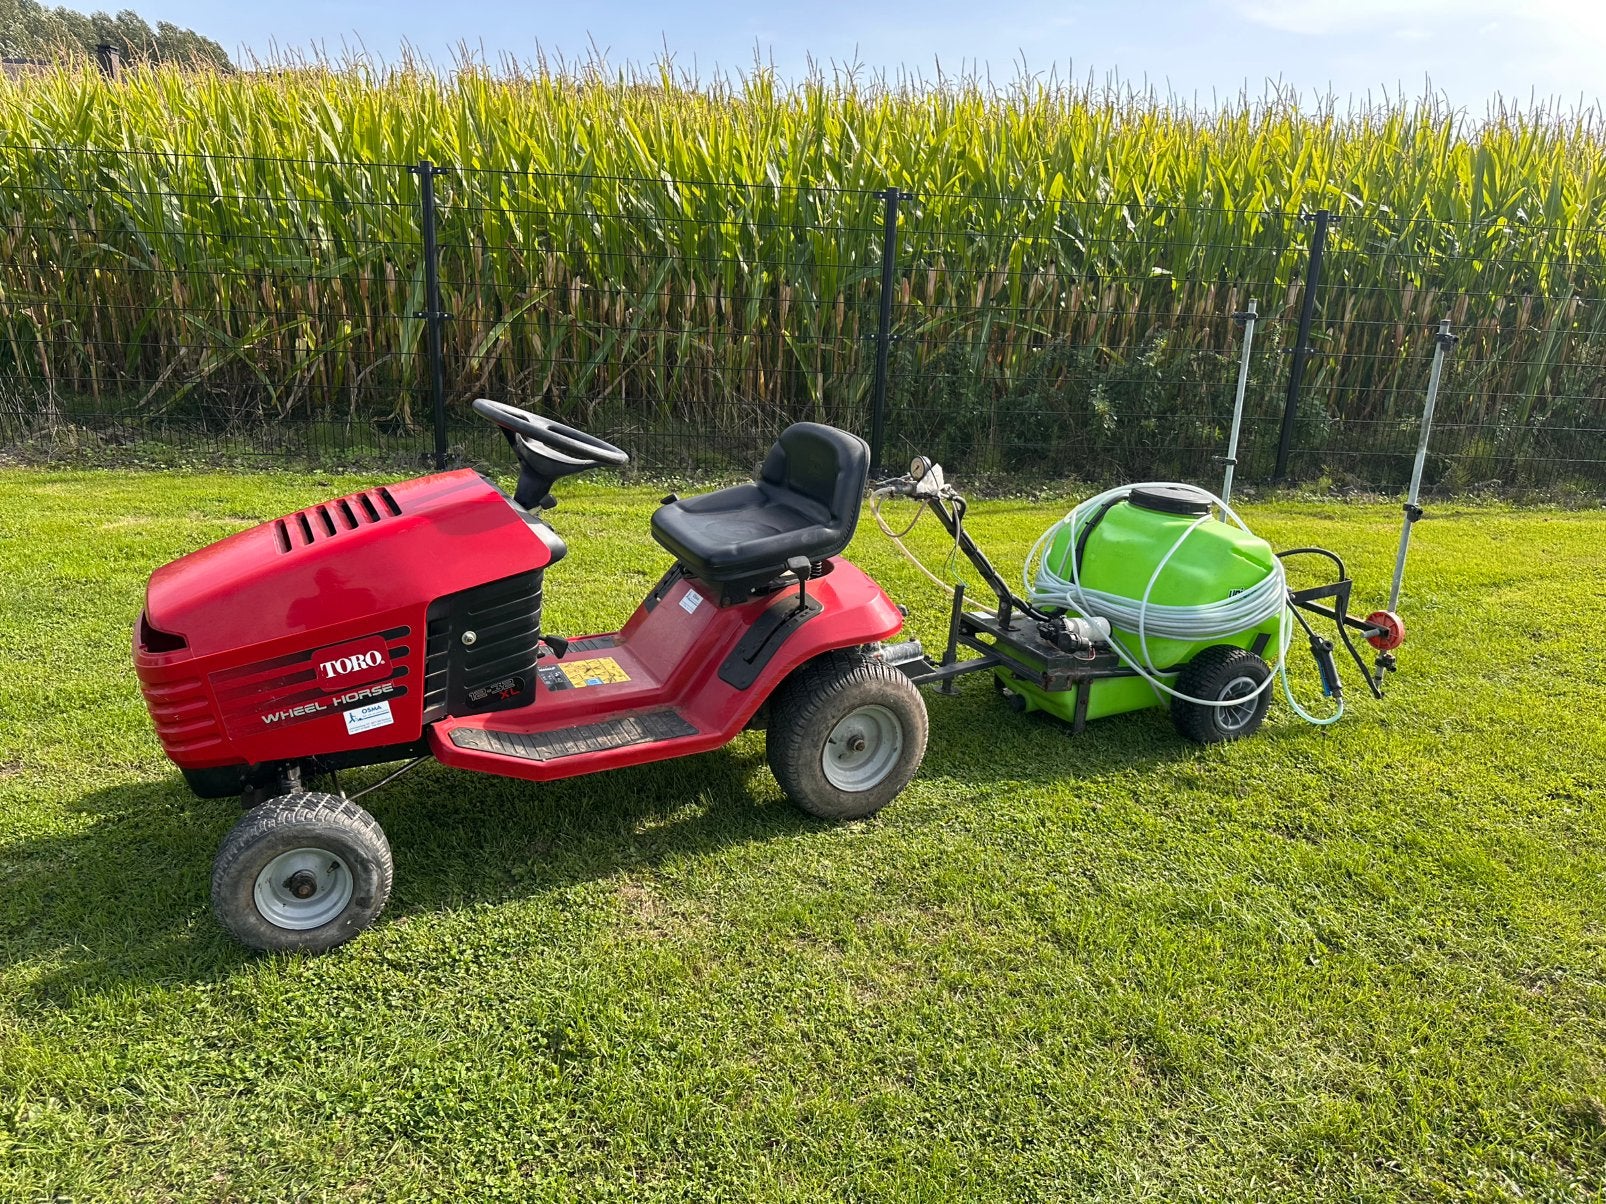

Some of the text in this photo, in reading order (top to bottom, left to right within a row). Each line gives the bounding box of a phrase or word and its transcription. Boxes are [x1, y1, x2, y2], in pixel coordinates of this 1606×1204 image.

[319, 650, 382, 679] TORO
[261, 683, 394, 724] WHEEL HORSE
[500, 688, 521, 700] XL
[361, 705, 382, 714] OSMA
